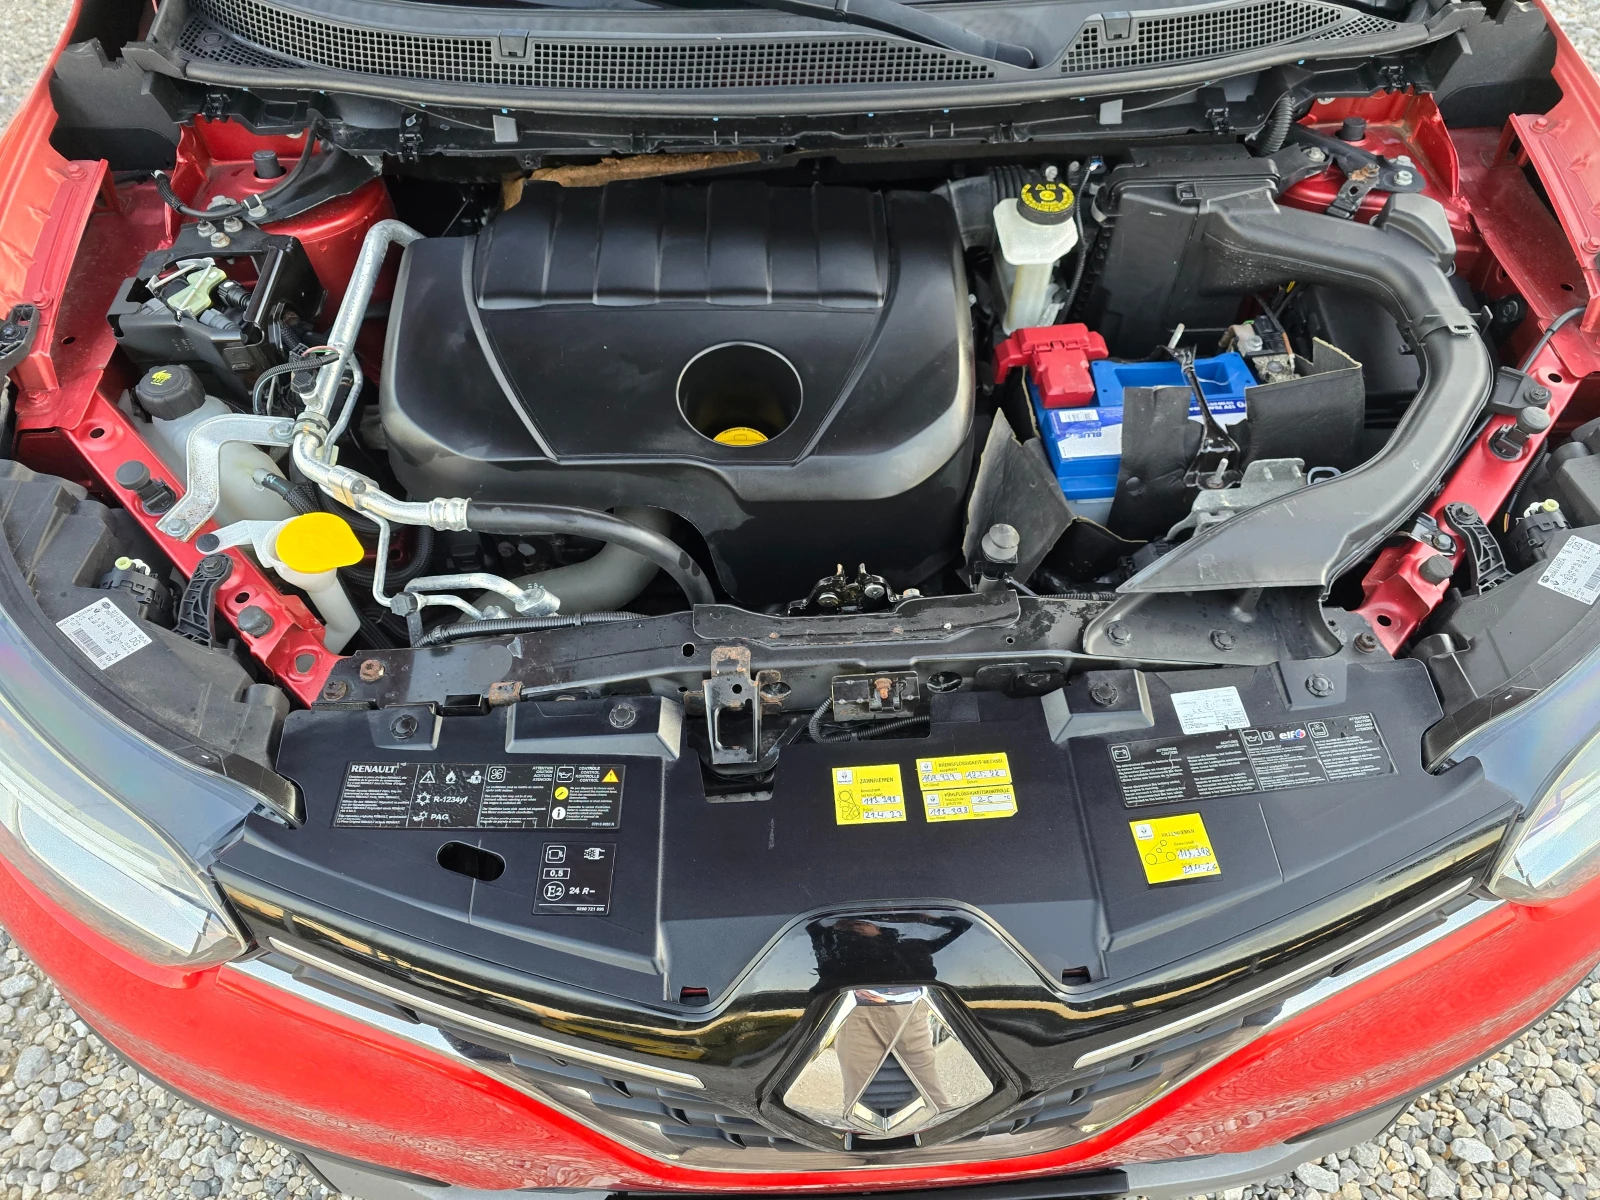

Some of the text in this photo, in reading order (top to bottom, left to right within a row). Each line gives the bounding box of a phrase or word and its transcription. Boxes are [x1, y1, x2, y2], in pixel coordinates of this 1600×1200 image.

[351, 765, 396, 773] RENAULT
[433, 796, 468, 804] R-1234yf
[550, 869, 564, 878] 0,5
[547, 886, 563, 897] E2
